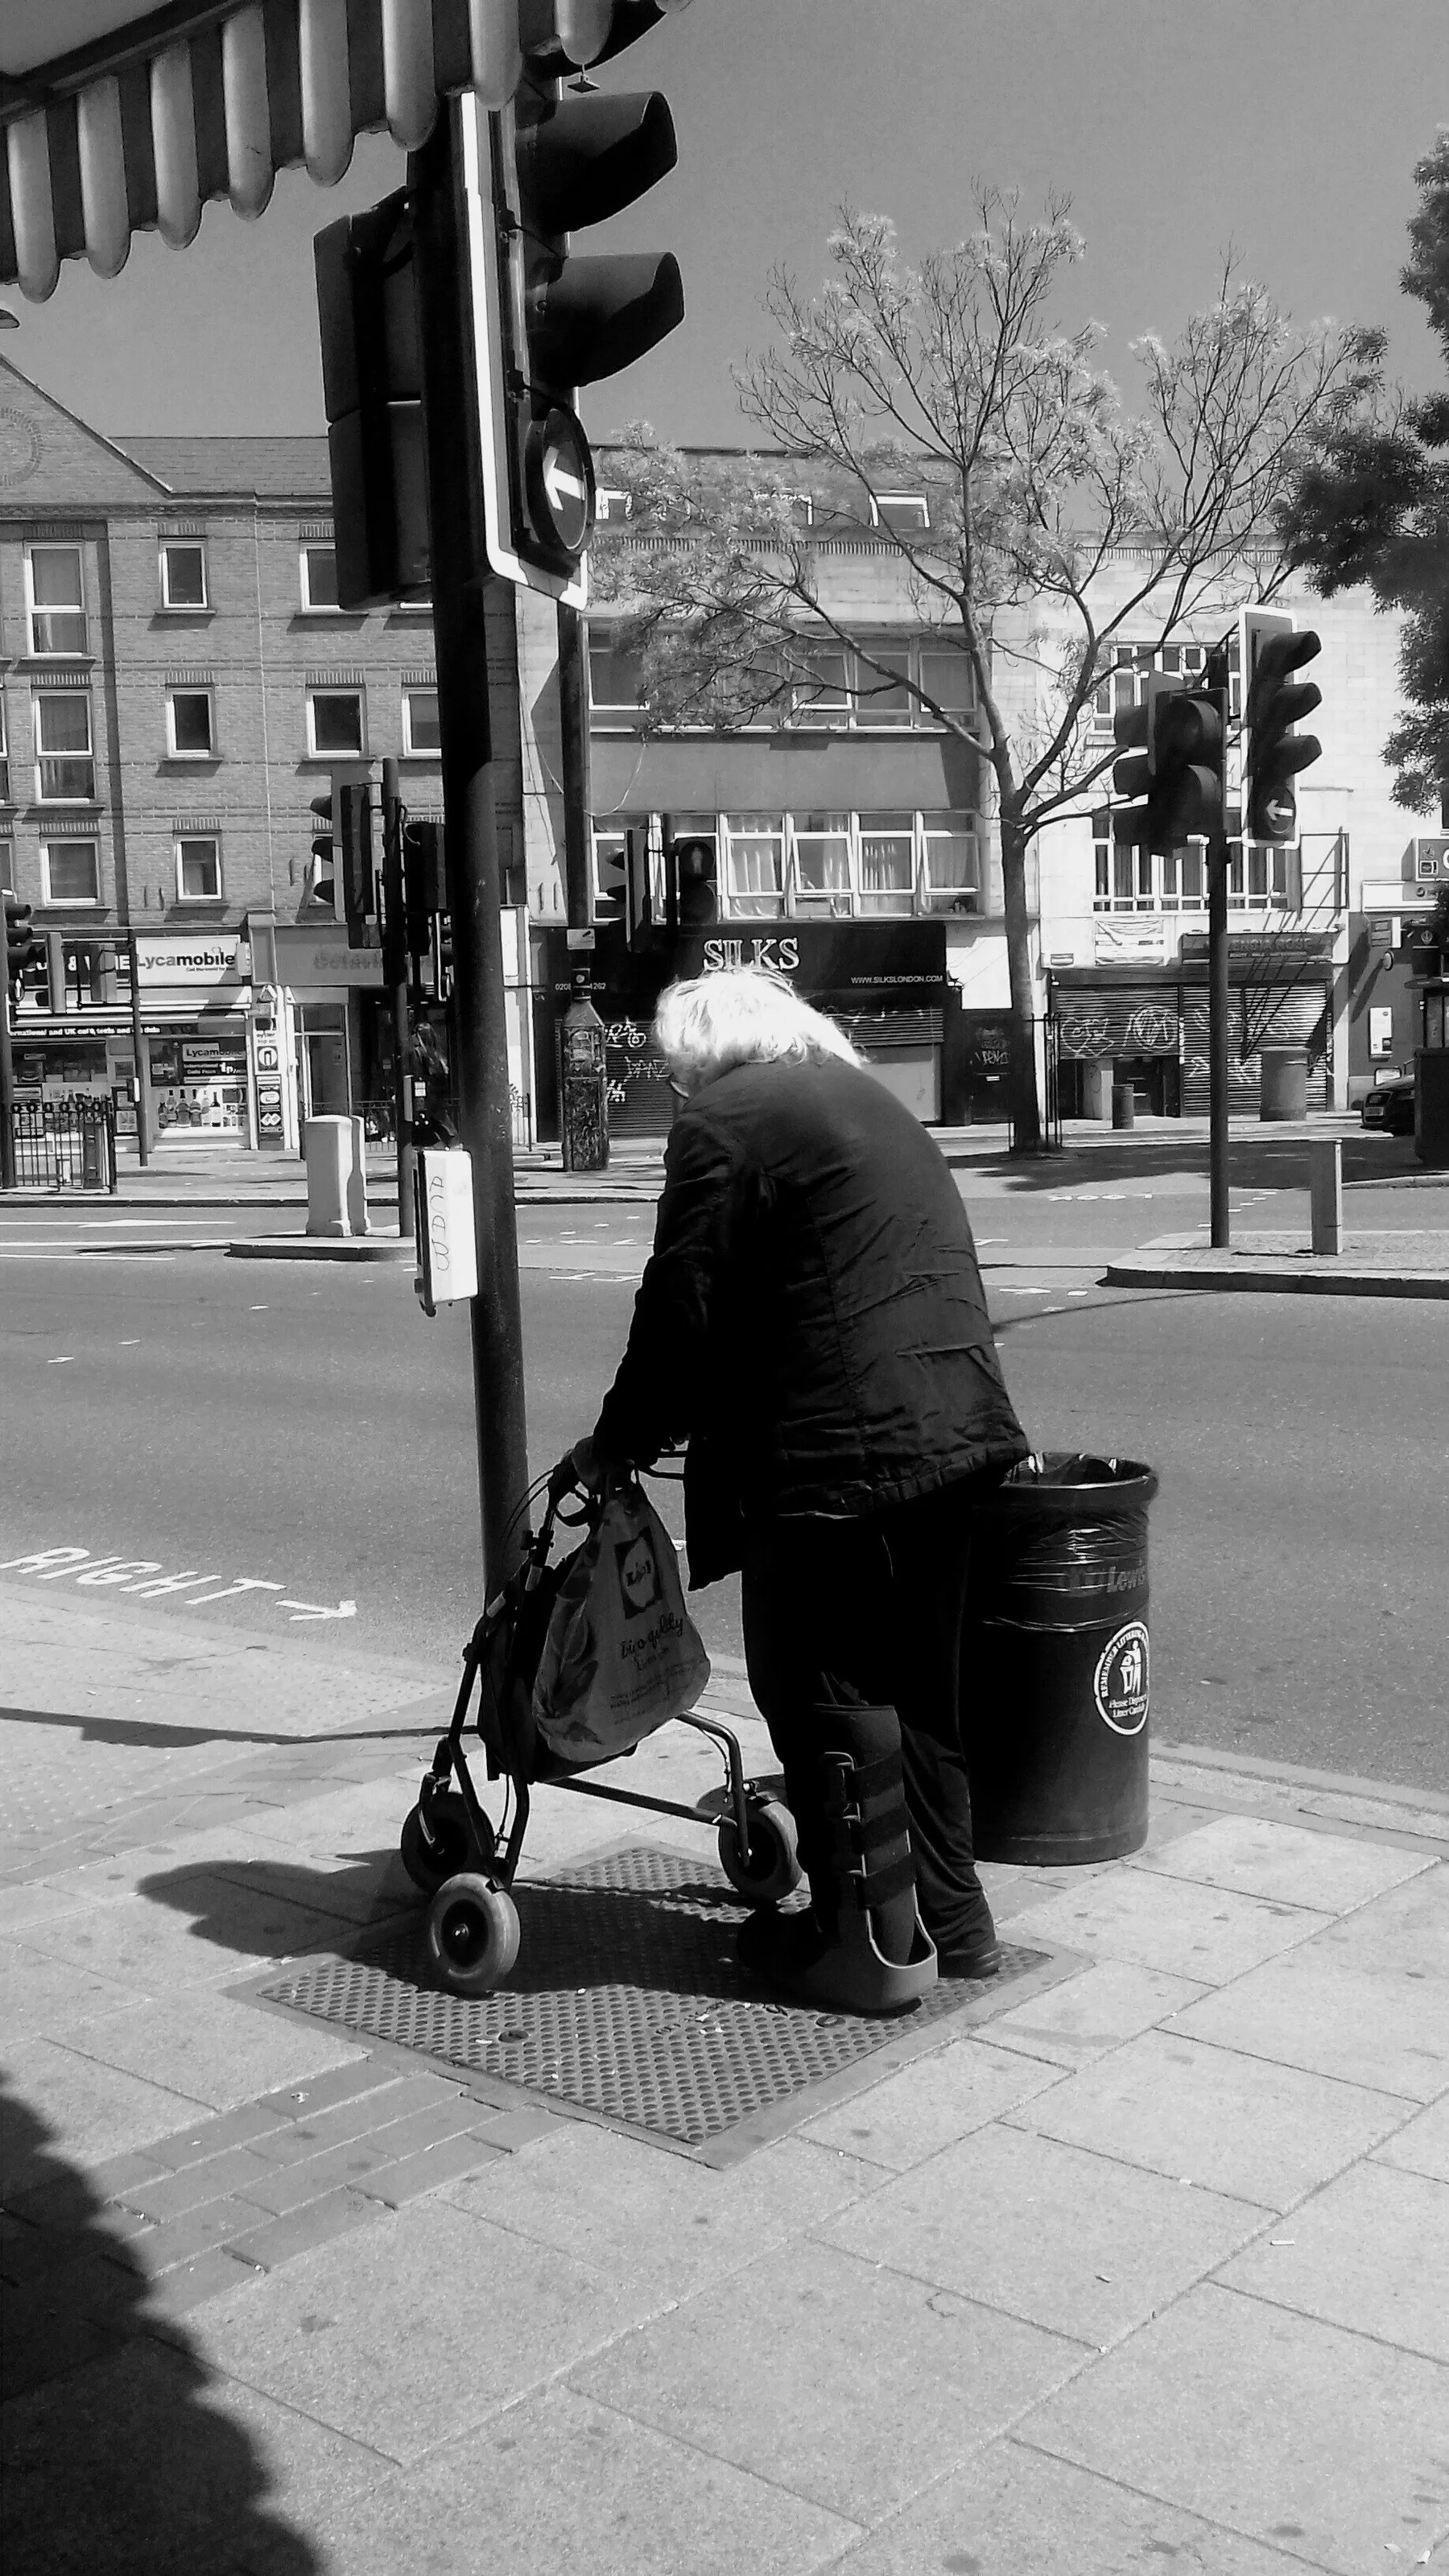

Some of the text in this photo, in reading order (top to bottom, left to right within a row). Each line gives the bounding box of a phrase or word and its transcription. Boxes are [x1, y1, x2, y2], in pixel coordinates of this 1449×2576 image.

[138, 952, 235, 969] Lycamobile
[703, 937, 799, 970] SILKS
[851, 975, 943, 984] WWW.SILKSLONDON.COM
[0, 1546, 287, 1605] RIGHT
[1108, 1699, 1129, 1708] Please
